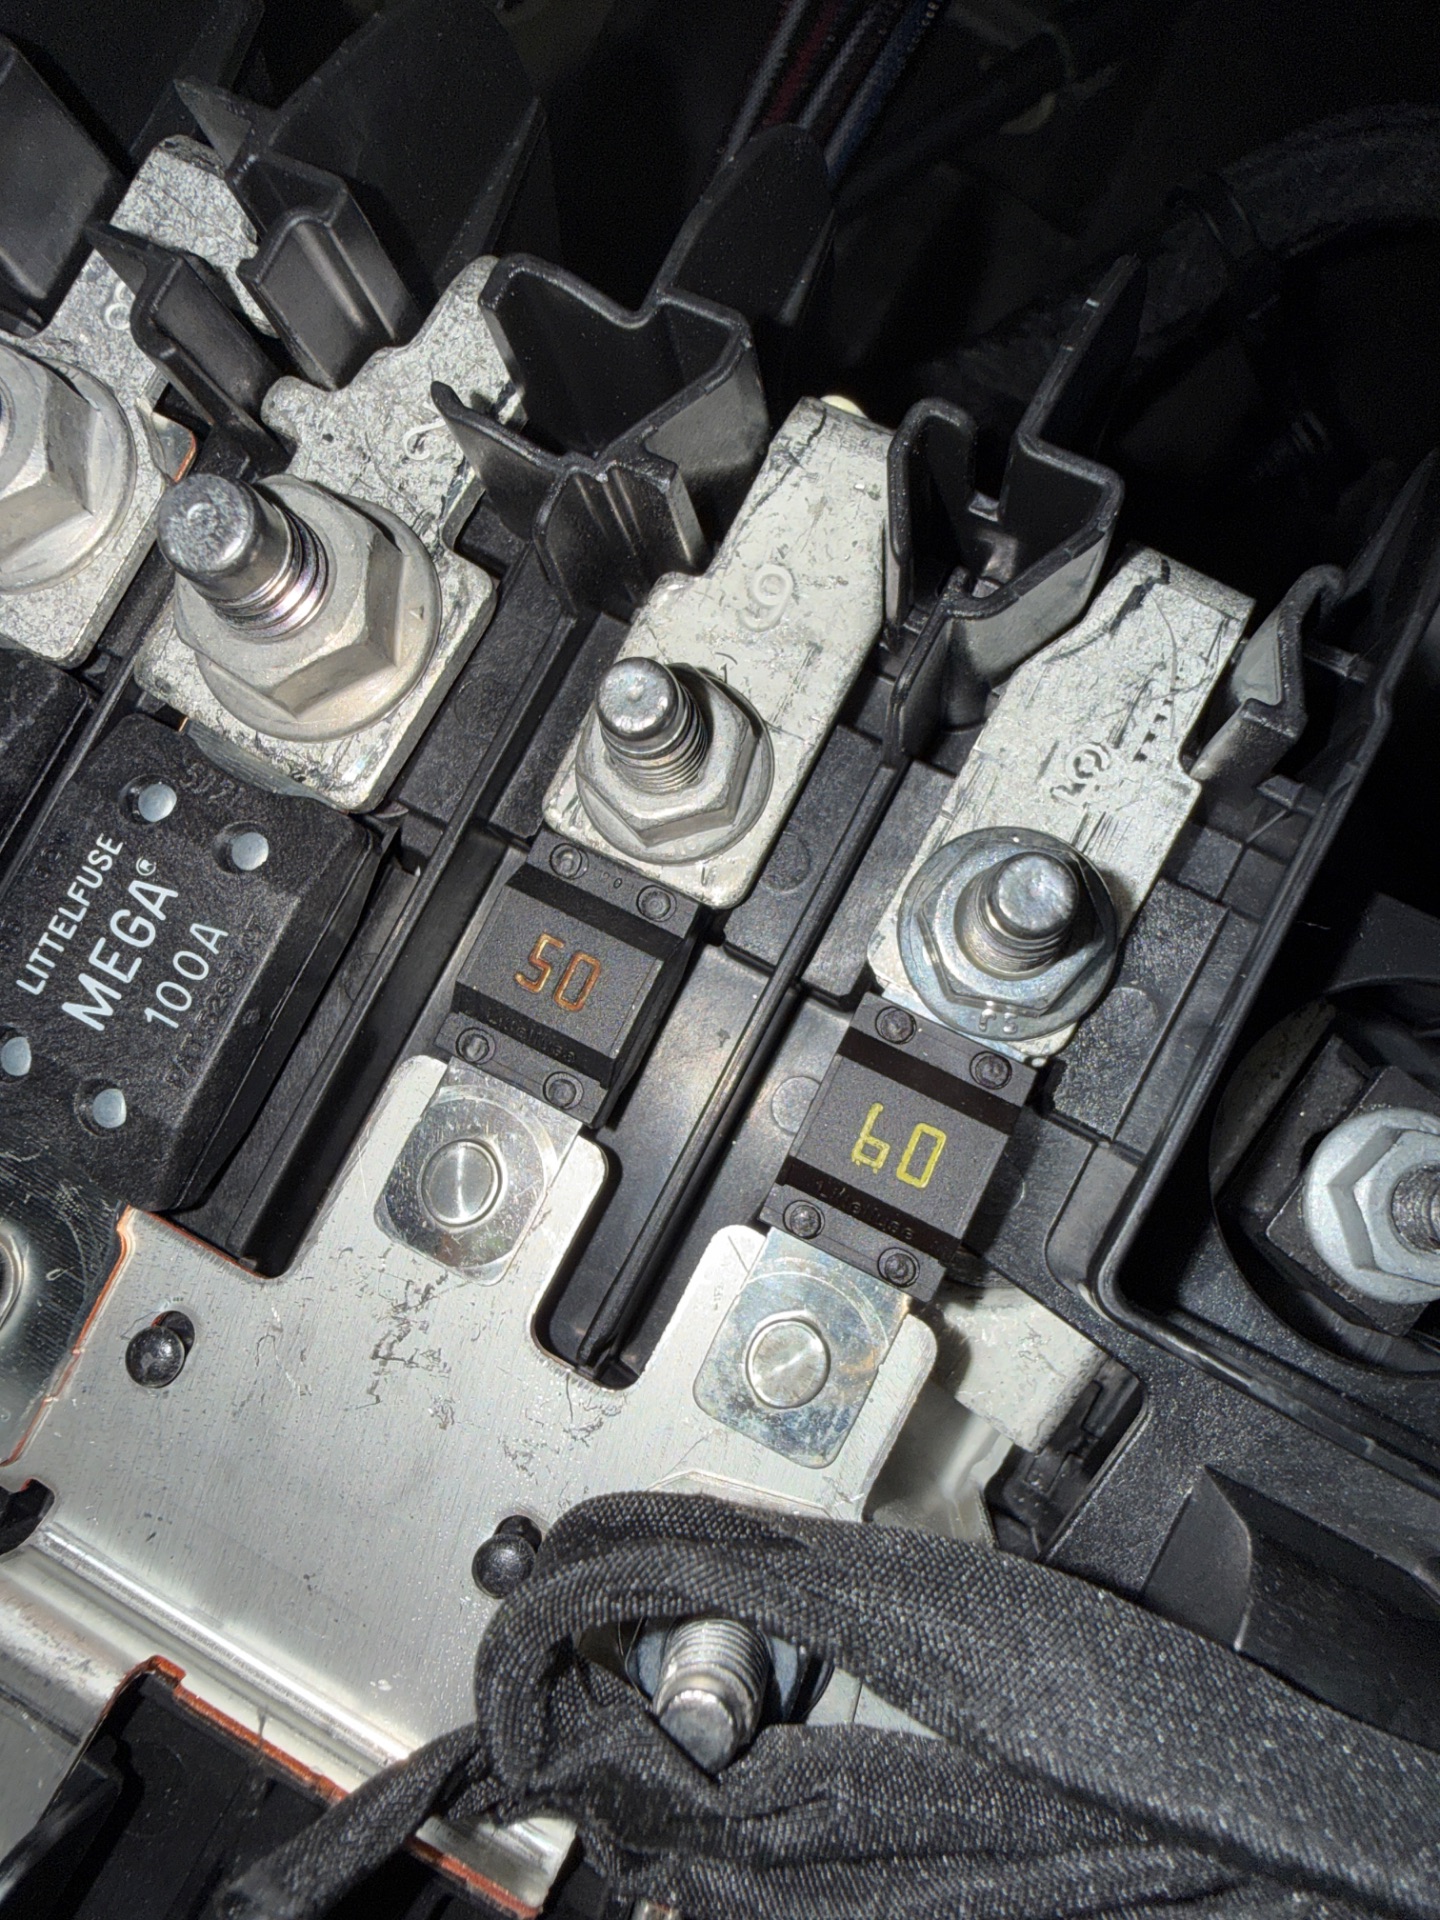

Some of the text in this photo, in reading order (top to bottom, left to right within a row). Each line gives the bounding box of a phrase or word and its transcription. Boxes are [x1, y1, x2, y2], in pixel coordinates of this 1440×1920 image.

[16, 833, 123, 995] LITTELFUSE
[144, 922, 229, 1029] 100A
[513, 930, 601, 1012] 50
[851, 1102, 947, 1188] 60
